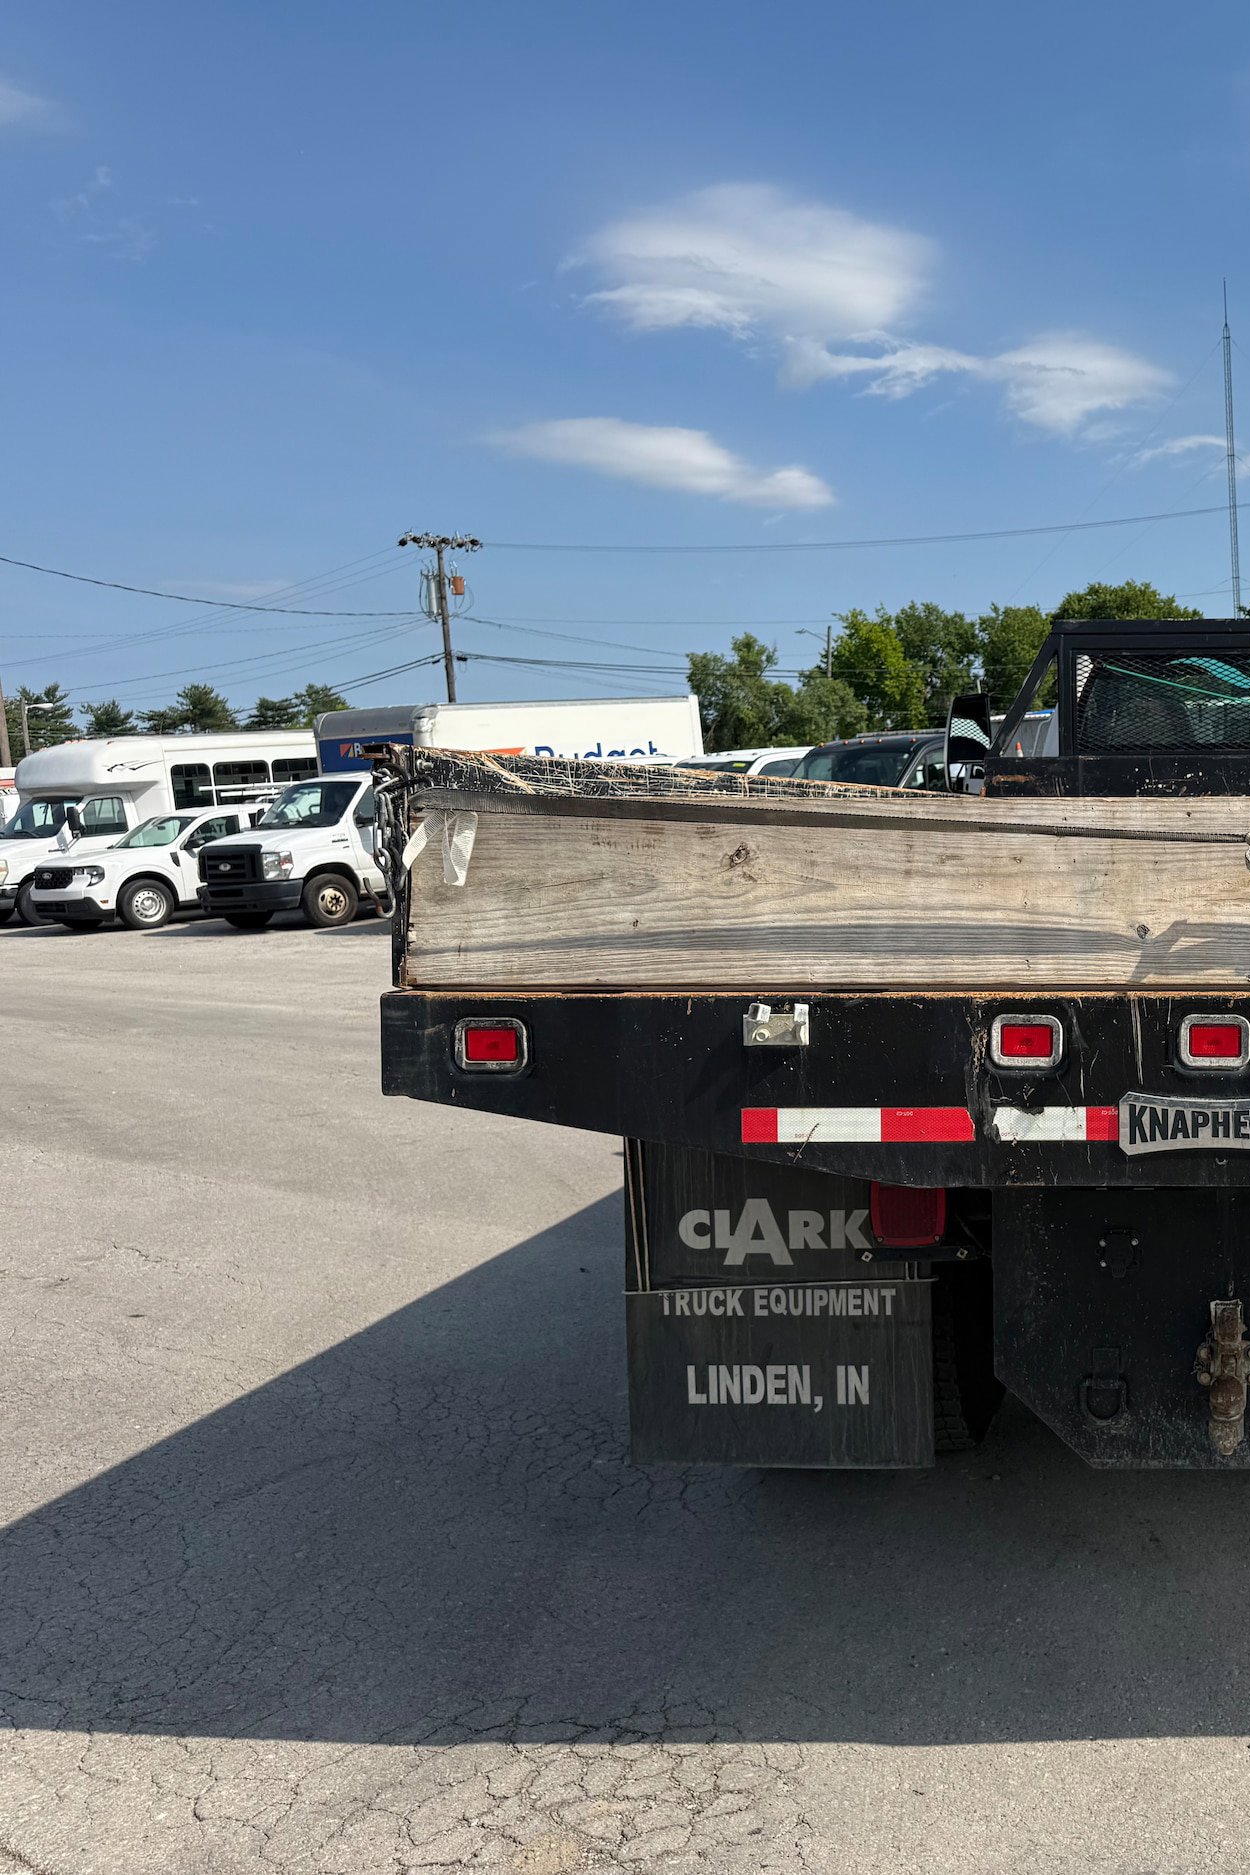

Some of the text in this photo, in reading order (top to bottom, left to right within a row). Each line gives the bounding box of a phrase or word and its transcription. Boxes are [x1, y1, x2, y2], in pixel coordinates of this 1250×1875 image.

[678, 1198, 873, 1265] CLARK
[659, 1288, 896, 1316] TRUCK EQUIPMENT
[687, 1364, 870, 1412] LINDEN, IN
